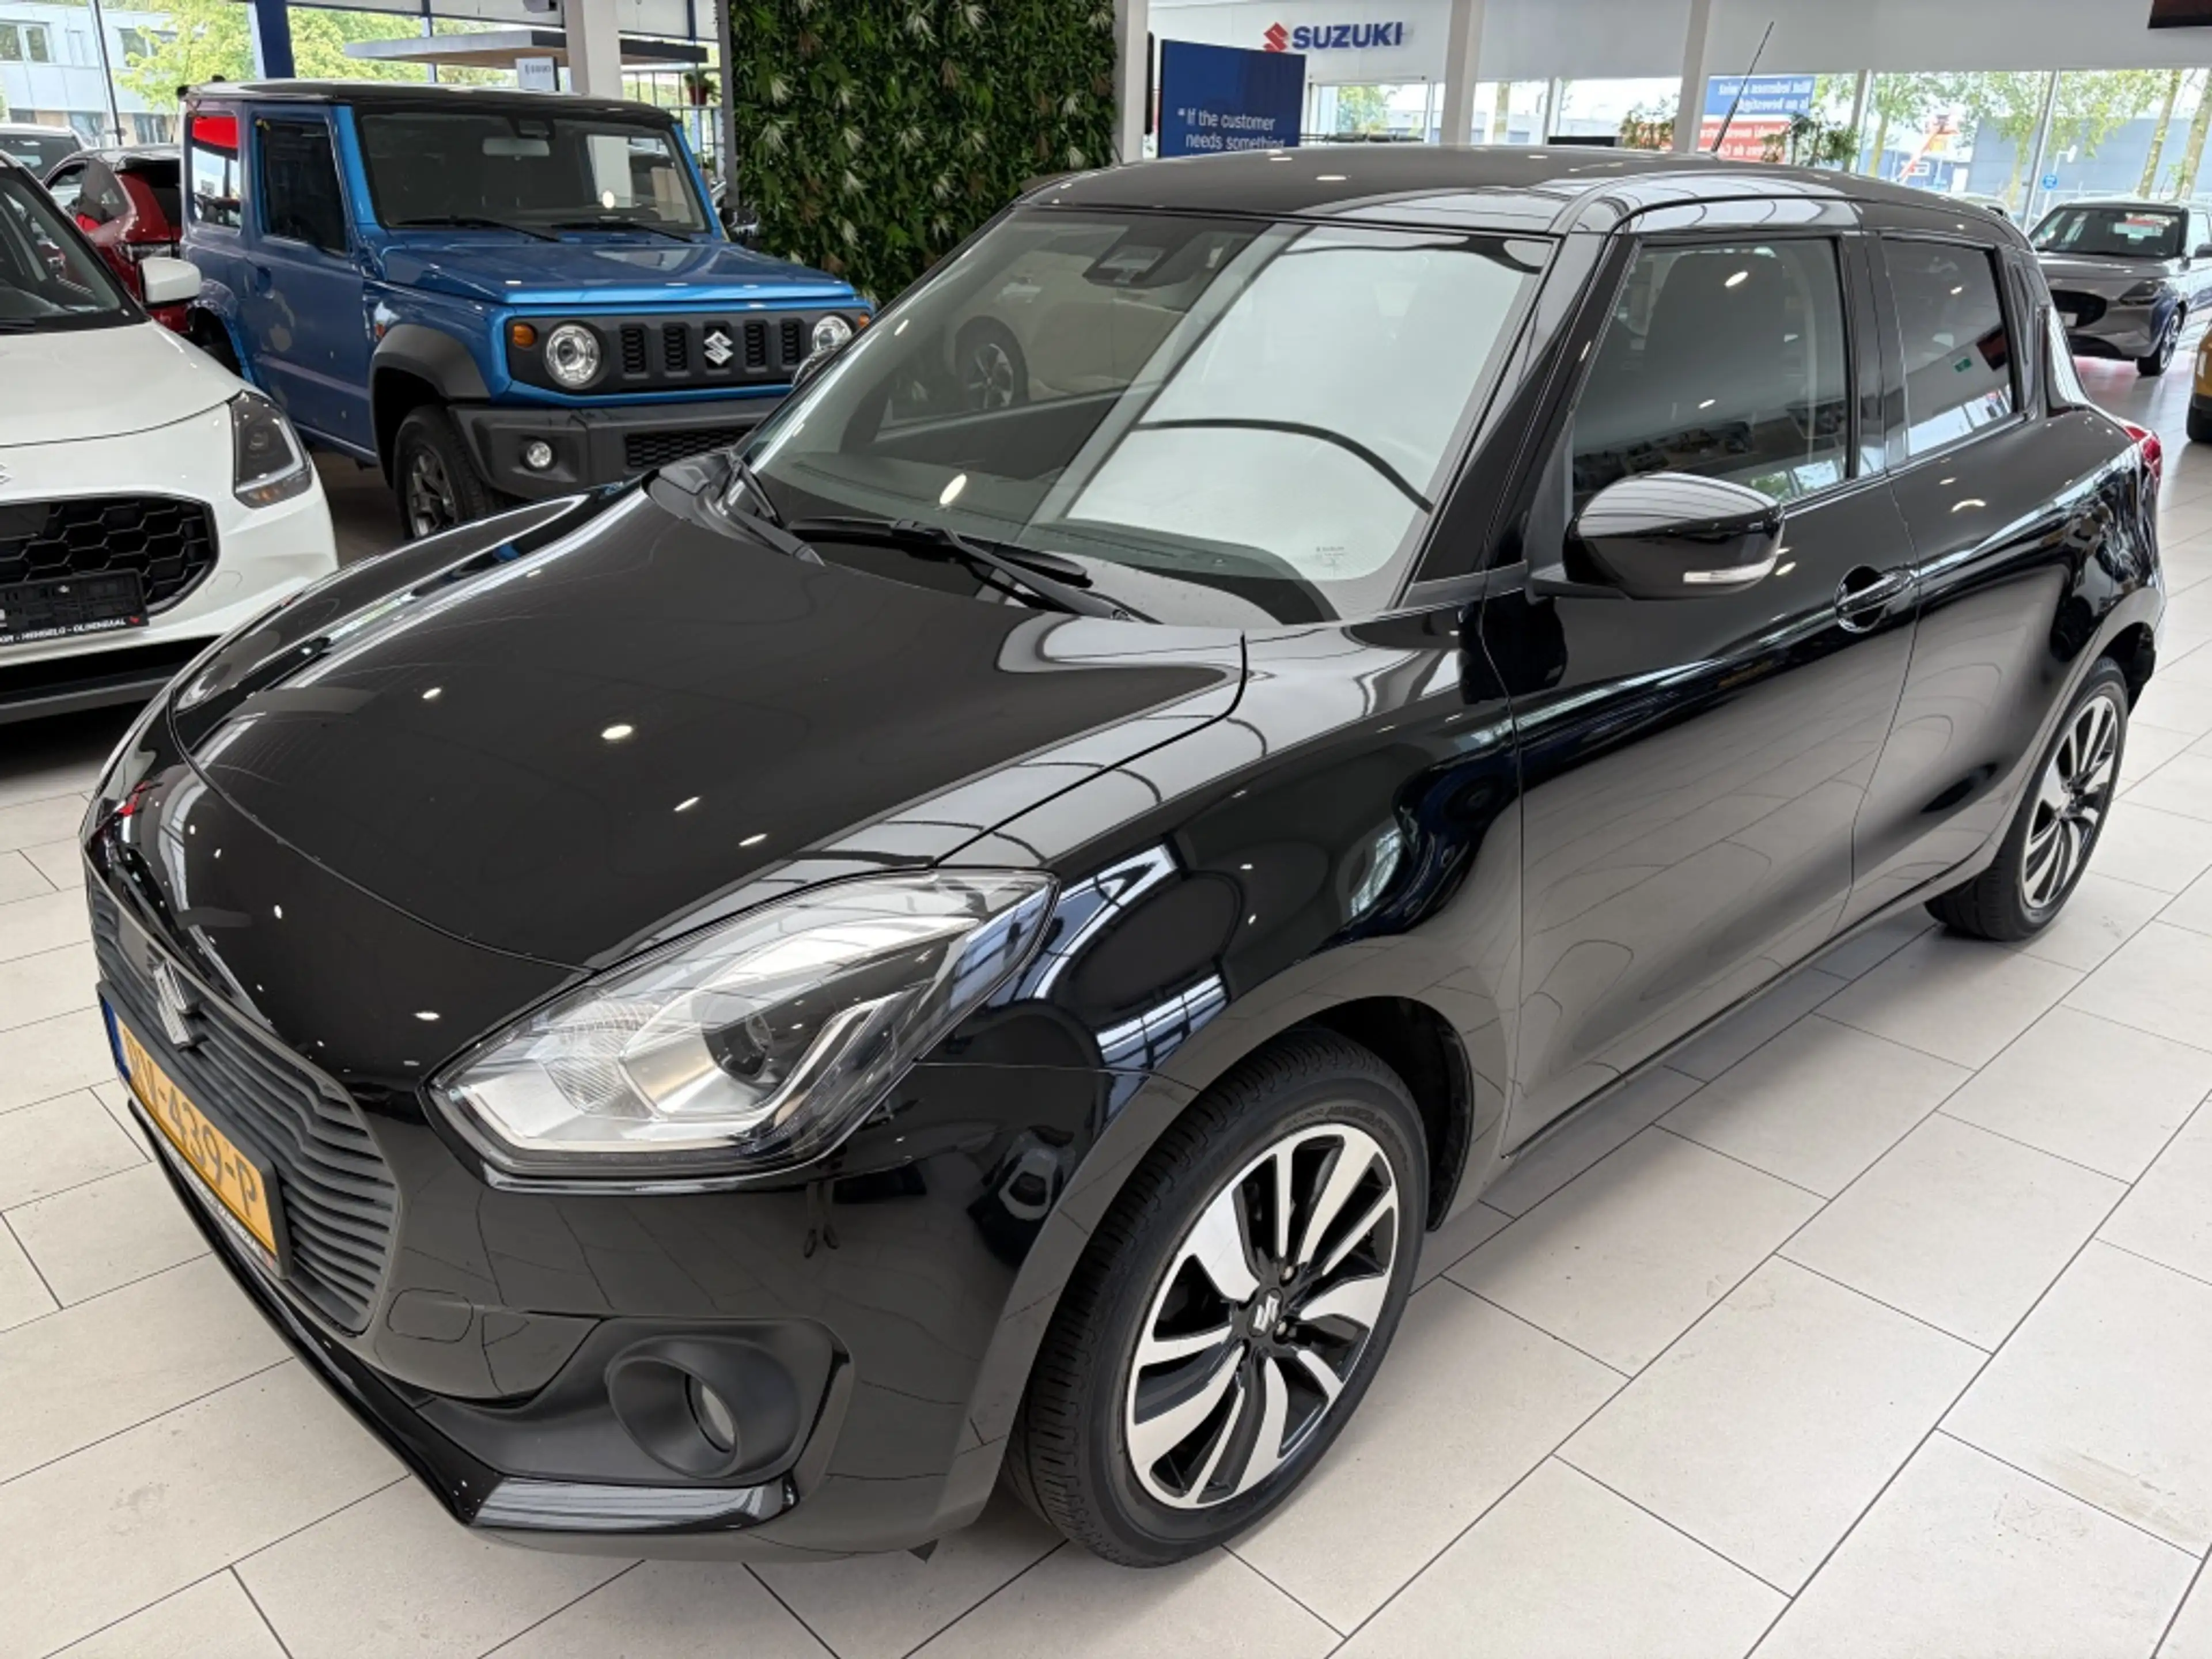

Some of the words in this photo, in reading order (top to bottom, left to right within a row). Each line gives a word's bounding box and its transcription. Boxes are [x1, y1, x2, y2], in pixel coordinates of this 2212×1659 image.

[1292, 21, 1403, 50] SUZUKI
[1199, 109, 1219, 127] the
[1221, 113, 1276, 131] customer
[1185, 132, 1224, 150] needs
